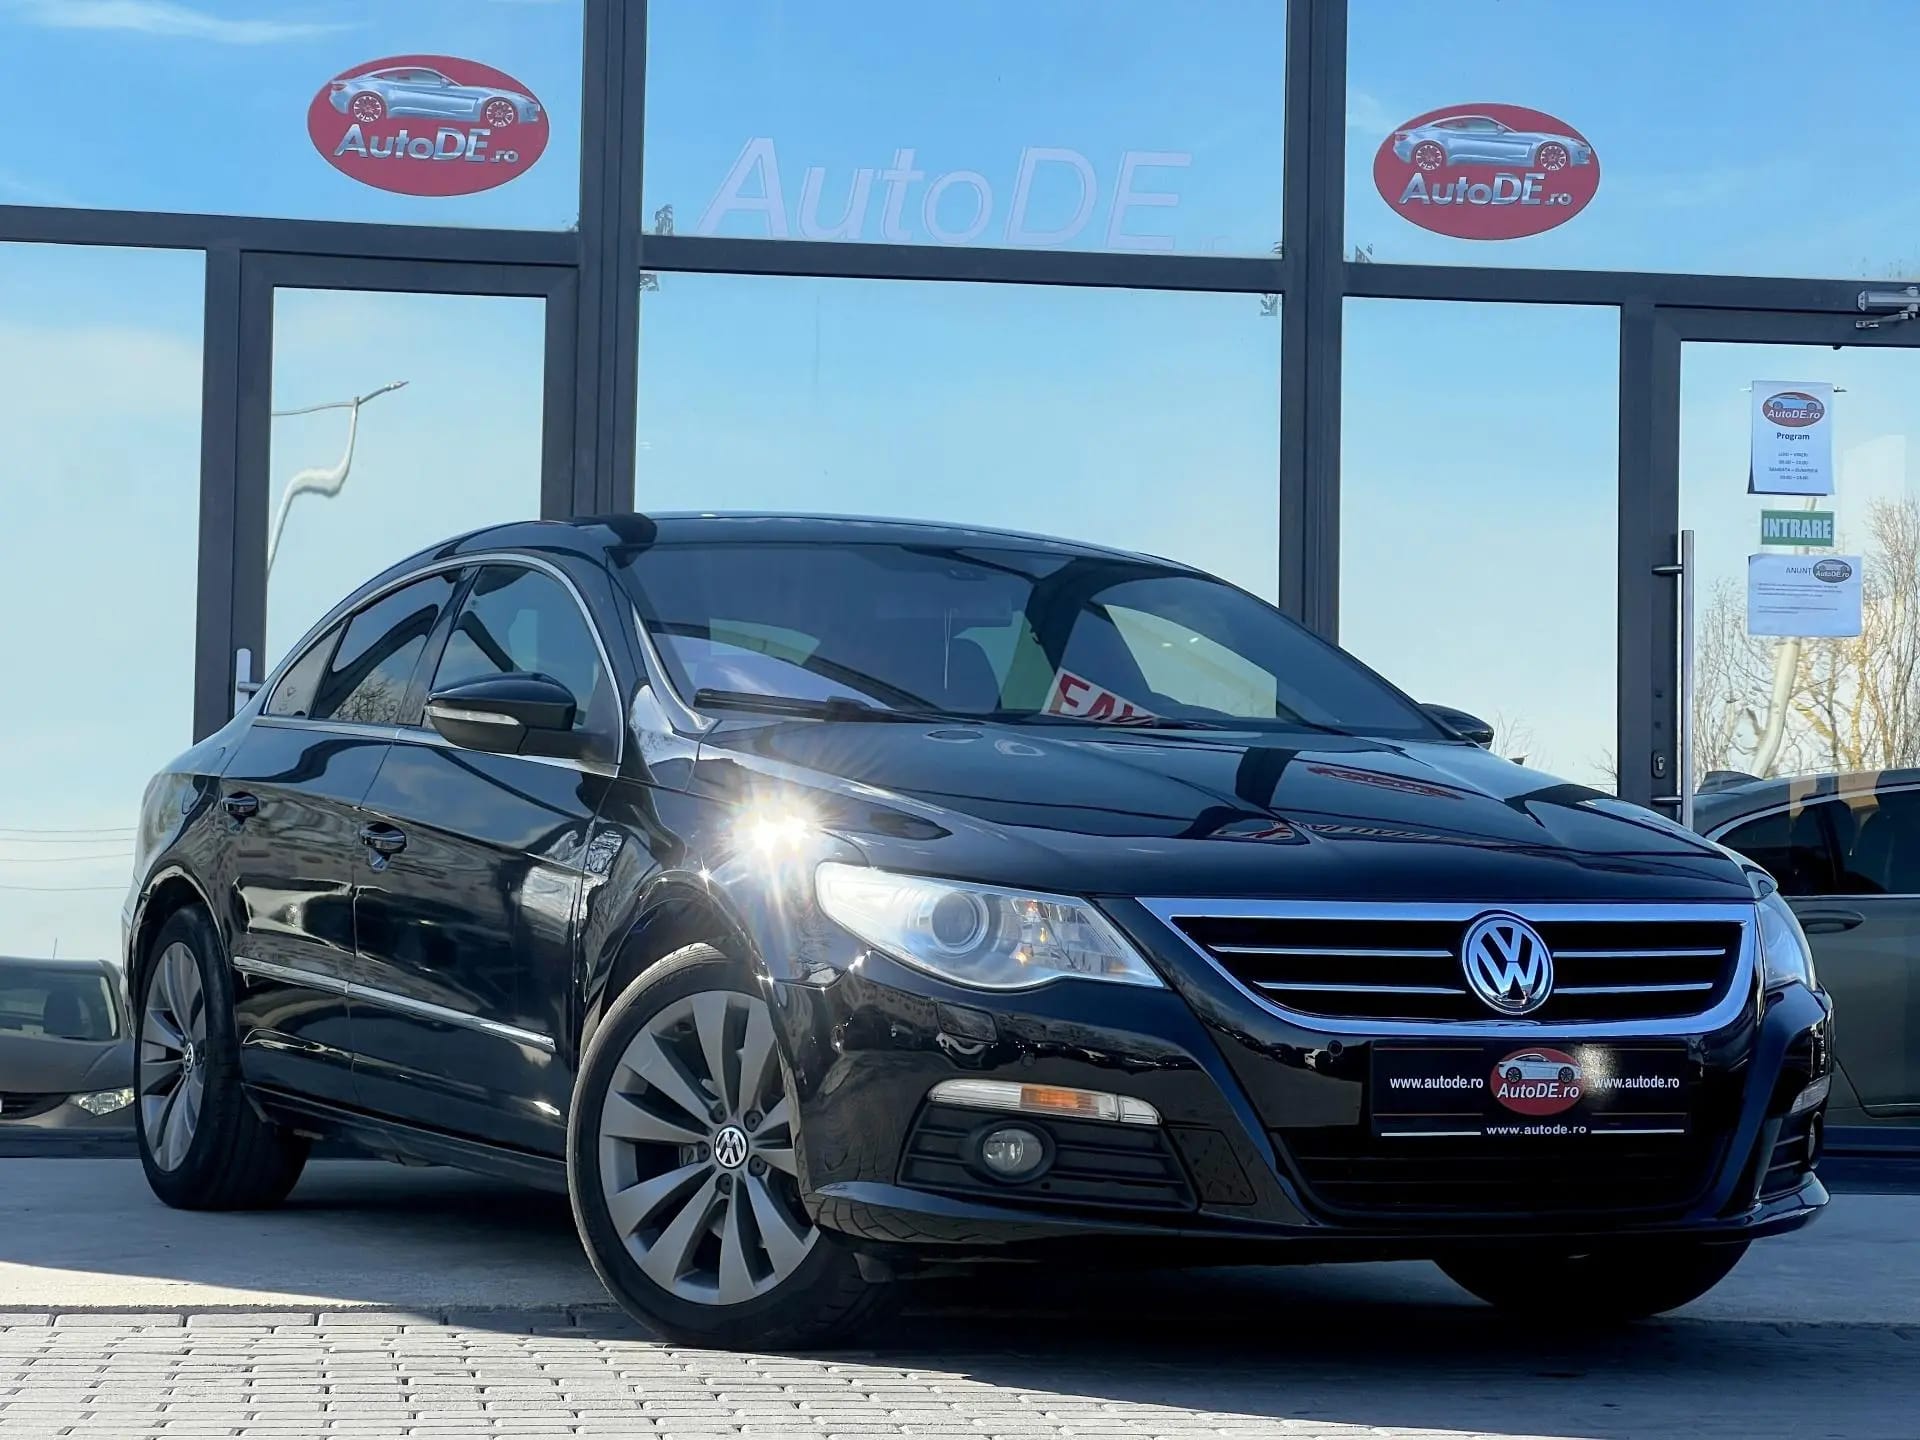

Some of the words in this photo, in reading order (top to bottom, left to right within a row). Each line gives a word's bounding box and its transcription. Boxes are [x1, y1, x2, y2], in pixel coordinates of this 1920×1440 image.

[696, 136, 1192, 251] AutoDE
[1767, 408, 1821, 420] AutoDE.ro
[1776, 431, 1811, 442] Program
[1763, 517, 1833, 540] INTRARE
[1389, 1075, 1484, 1090] www.autode.ro
[1593, 1075, 1680, 1090] www.autode.ro
[1497, 1082, 1581, 1100] AutoDE.ro
[1486, 1124, 1588, 1136] www.autode.ro
